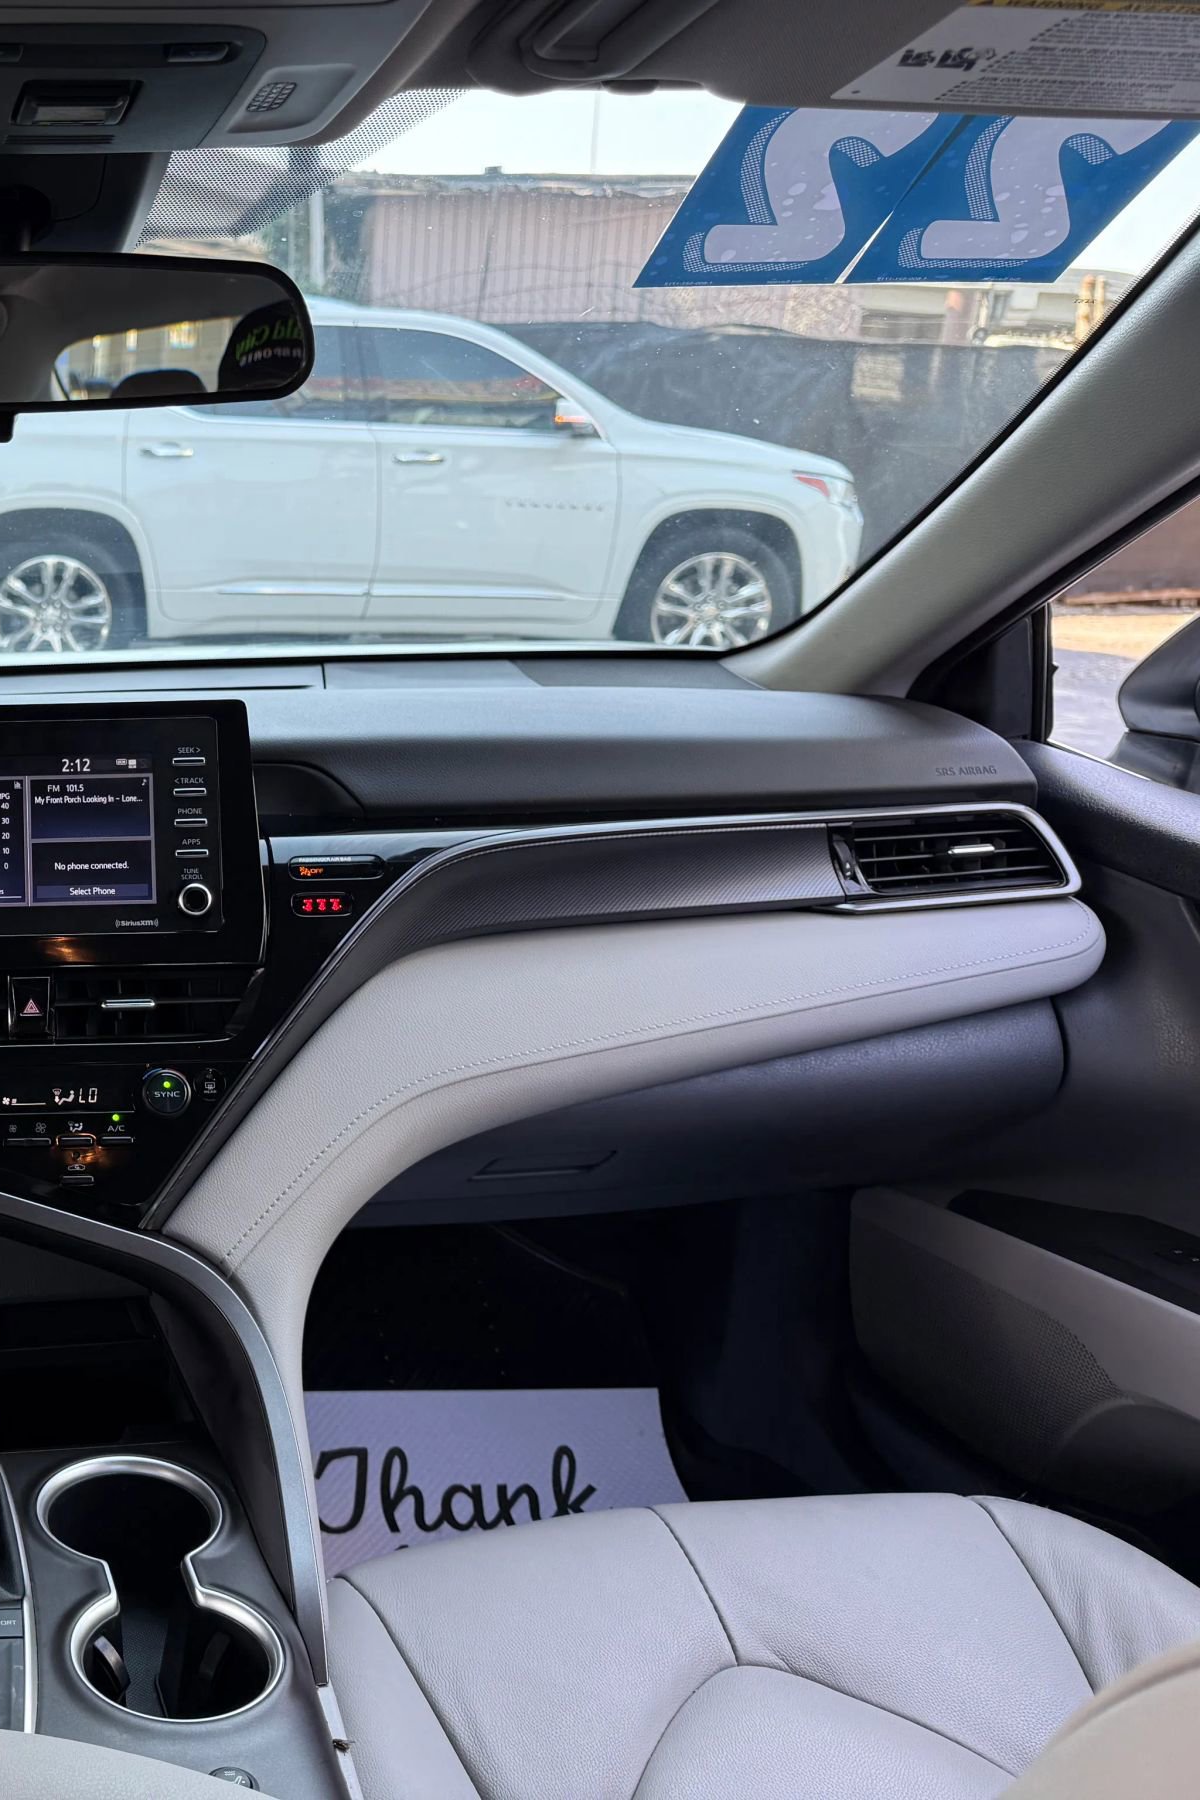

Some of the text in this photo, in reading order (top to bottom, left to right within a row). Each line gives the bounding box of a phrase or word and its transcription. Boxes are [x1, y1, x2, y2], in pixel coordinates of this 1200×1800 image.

[61, 758, 91, 772] 2:12
[935, 765, 997, 776] SRS AIRBAG
[66, 784, 84, 792] 101.5
[34, 796, 45, 805] My
[45, 796, 63, 804] Front
[64, 796, 81, 804] Porch
[82, 795, 107, 805] Looking
[54, 860, 130, 872] No phone connected.
[69, 886, 116, 896] Select Phone
[154, 1090, 181, 1098] SYNC
[107, 1124, 126, 1132] A/C
[314, 1444, 597, 1533] Thank
